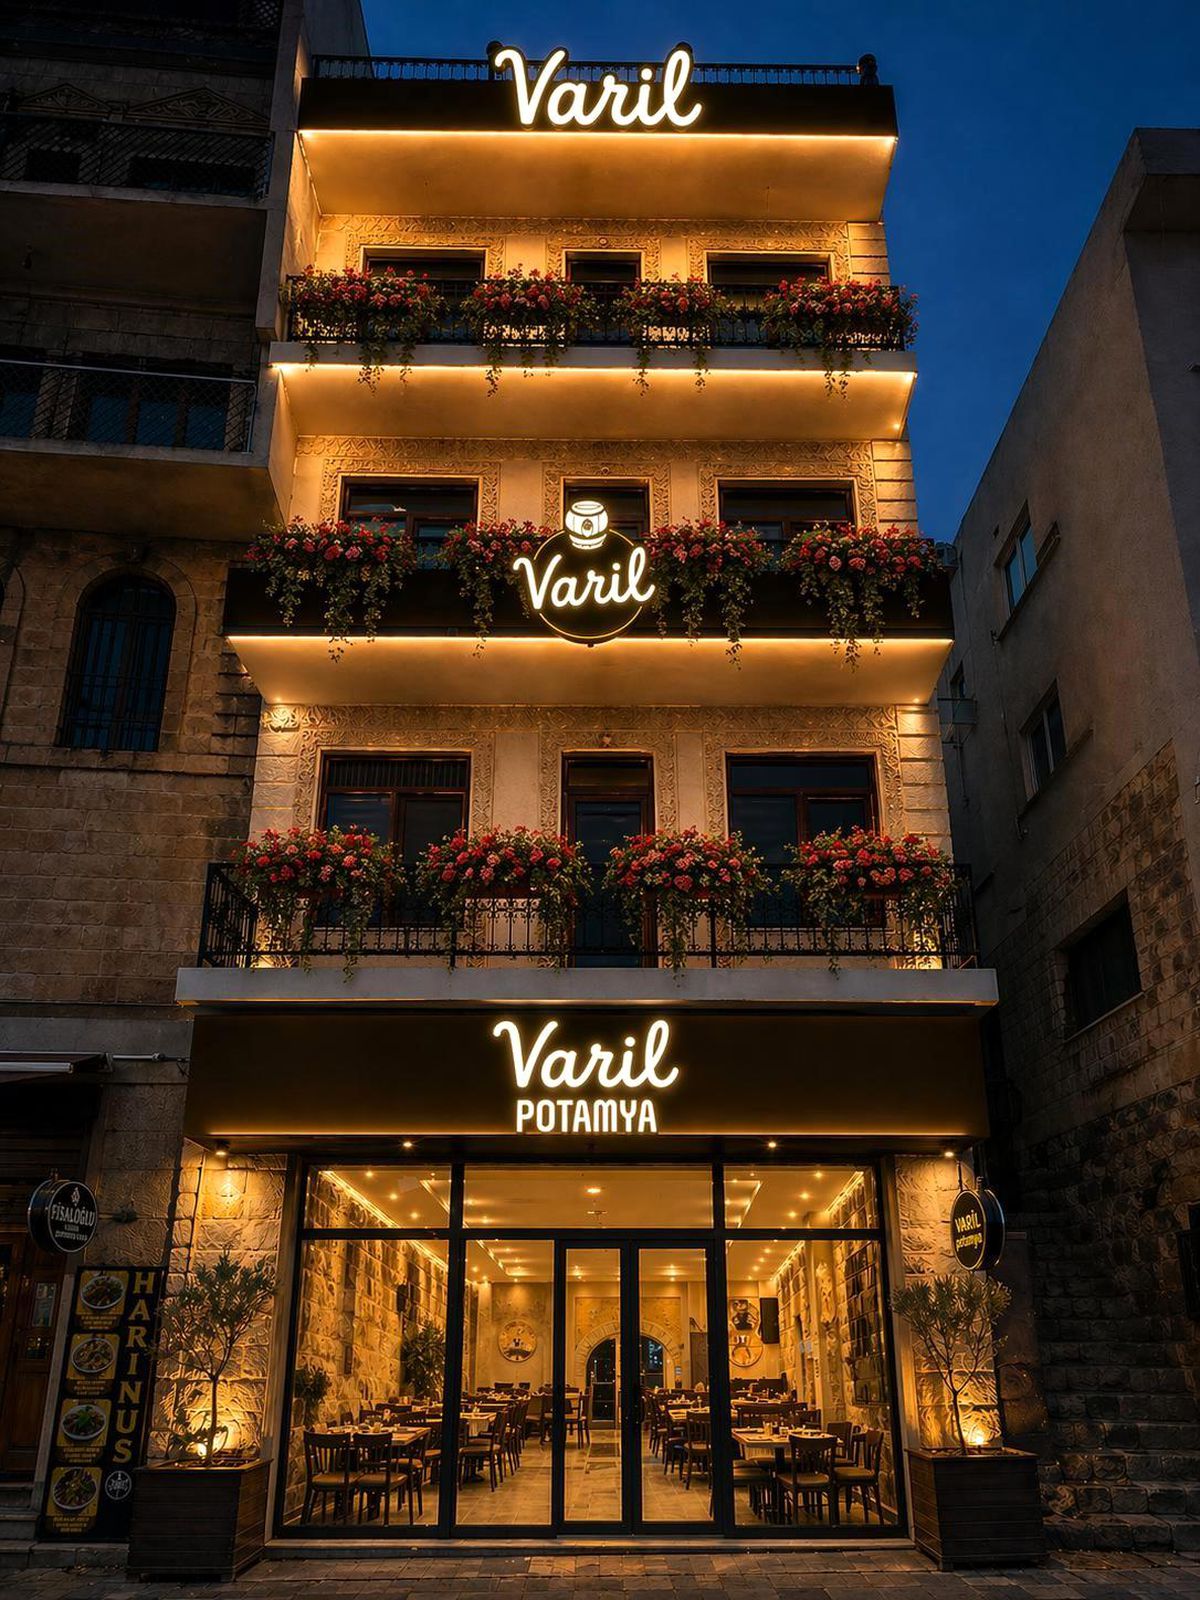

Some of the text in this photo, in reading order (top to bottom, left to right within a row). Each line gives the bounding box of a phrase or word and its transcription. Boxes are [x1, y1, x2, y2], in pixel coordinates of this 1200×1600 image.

[494, 50, 703, 126] Varil
[513, 547, 656, 610] Varil
[493, 1020, 679, 1088] Varil
[516, 1099, 657, 1133] POTAMYA
